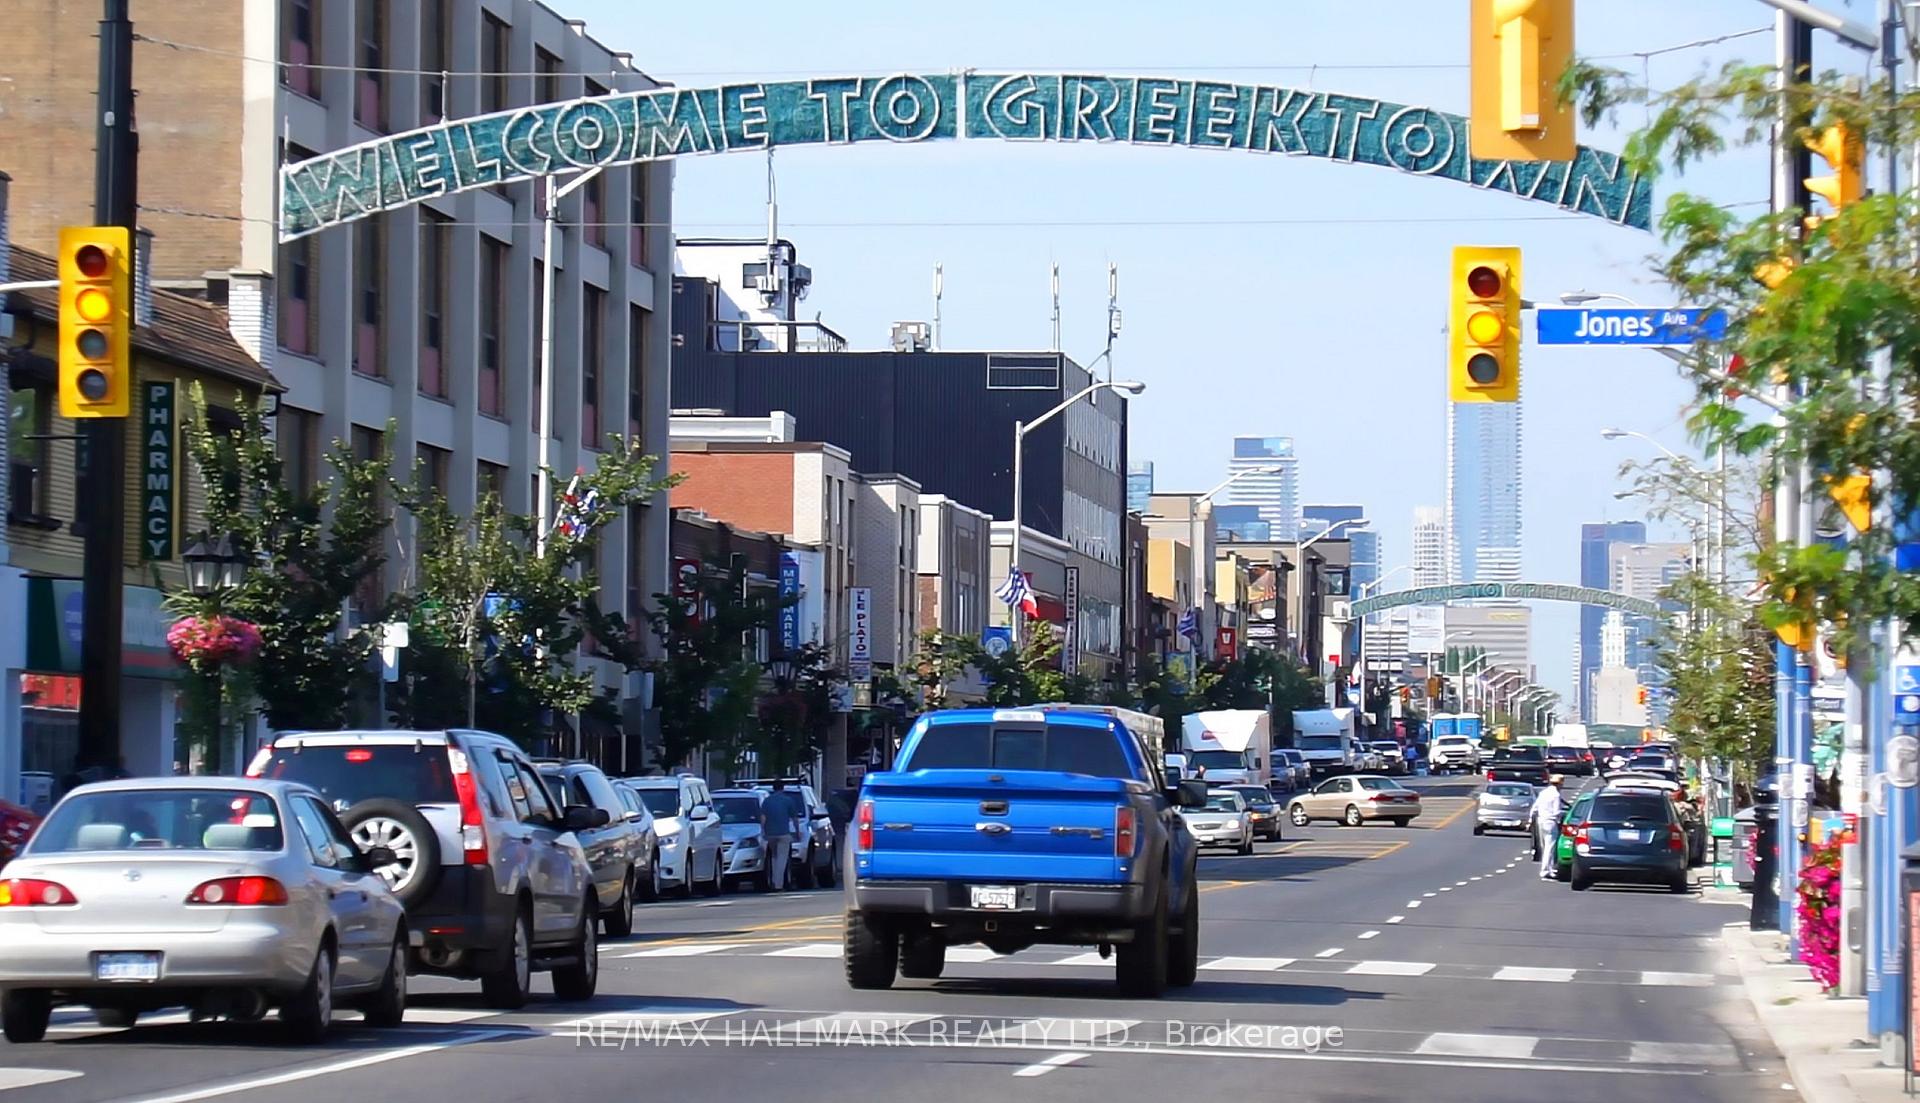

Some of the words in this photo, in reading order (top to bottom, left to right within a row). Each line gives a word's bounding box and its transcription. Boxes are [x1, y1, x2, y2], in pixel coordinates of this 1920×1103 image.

[286, 80, 769, 228] WELCOME
[806, 72, 940, 143] TO
[1574, 311, 1654, 337] Jones
[1662, 312, 1688, 325] Ave
[147, 386, 169, 556] PHARMACY
[856, 613, 866, 652] PLATO
